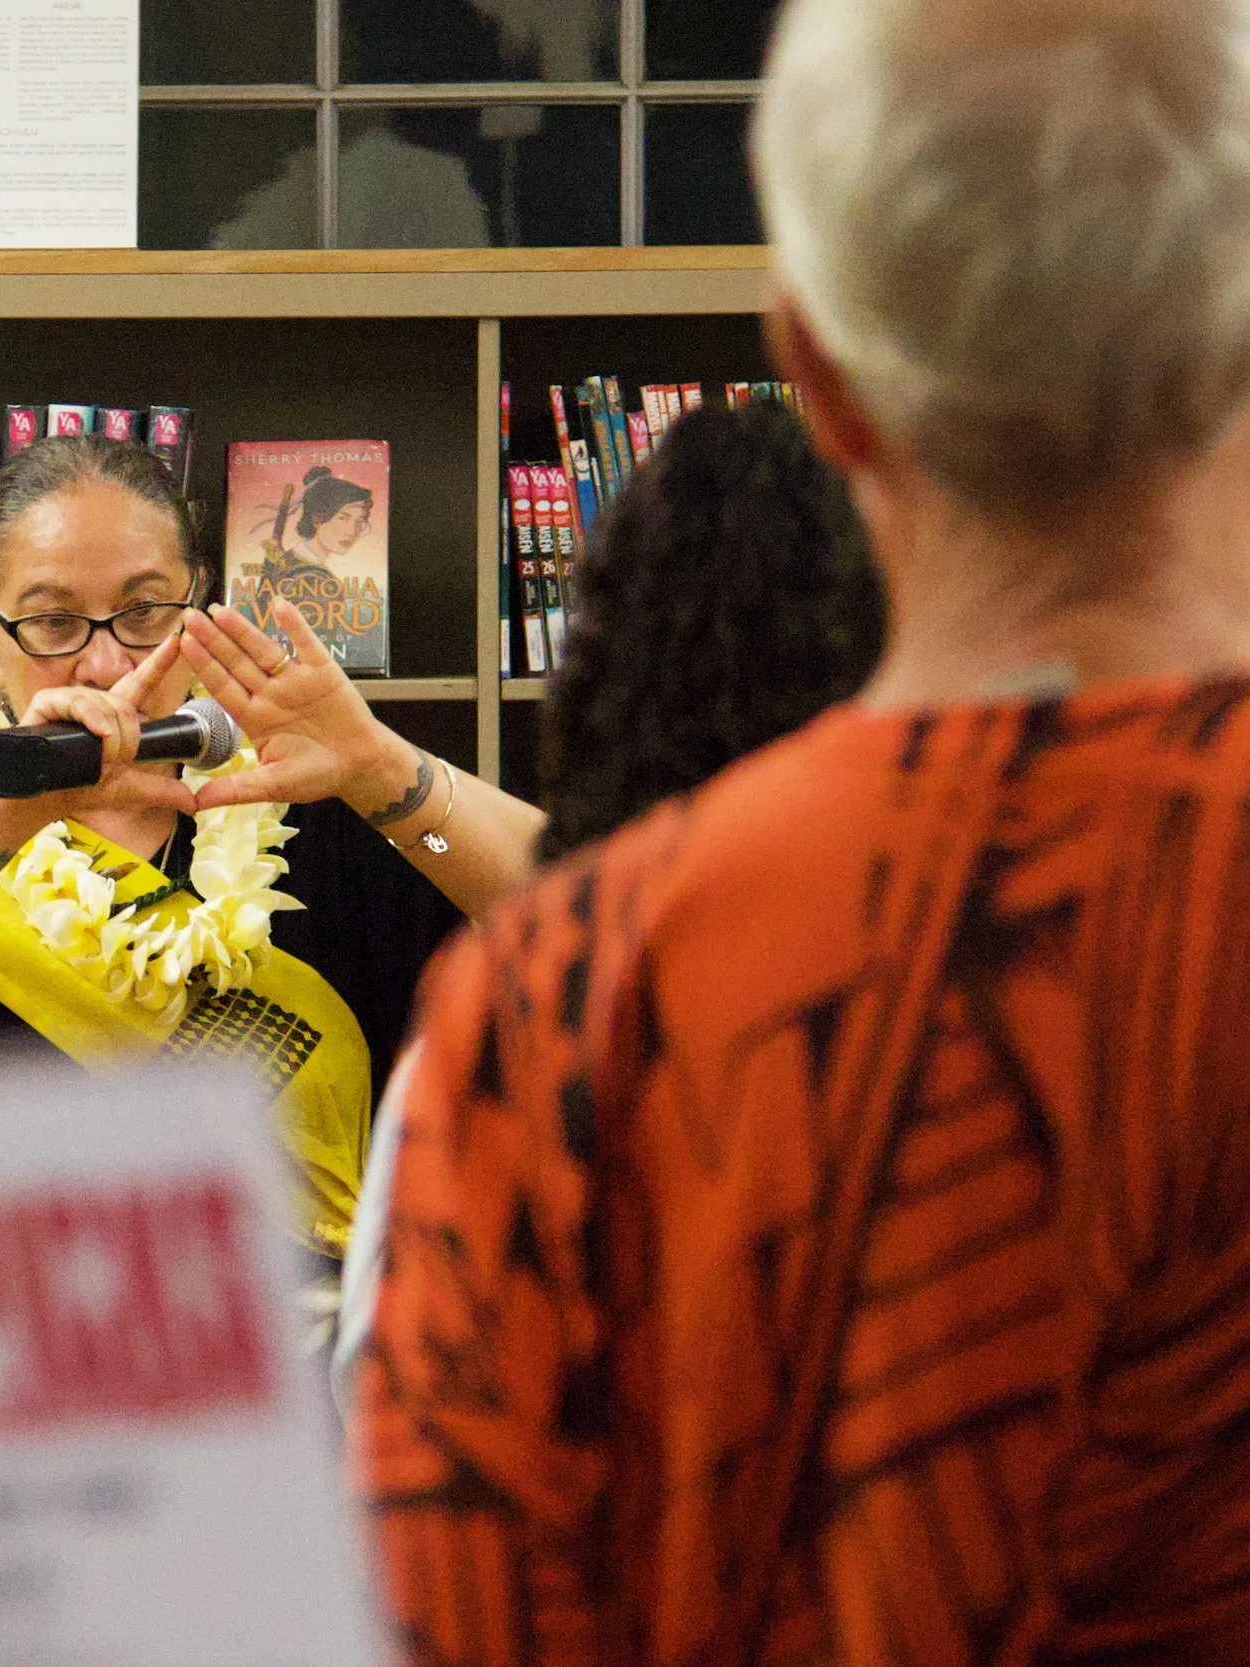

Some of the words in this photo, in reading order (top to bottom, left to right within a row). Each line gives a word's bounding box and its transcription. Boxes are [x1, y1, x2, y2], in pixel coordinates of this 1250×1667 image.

[13, 413, 31, 432] YA
[59, 413, 77, 432] YA
[108, 411, 127, 430] YA
[158, 415, 177, 434] YA
[233, 453, 302, 465] SHERRY
[309, 452, 383, 465] THOMAS
[509, 468, 529, 488] YA
[530, 467, 550, 487] YA
[516, 524, 534, 554] AISEN
[538, 525, 554, 554] AISEN
[557, 526, 573, 555] AISEN
[521, 560, 535, 575] 25
[231, 575, 385, 600] MAGNOLIA
[231, 599, 382, 636] WORD
